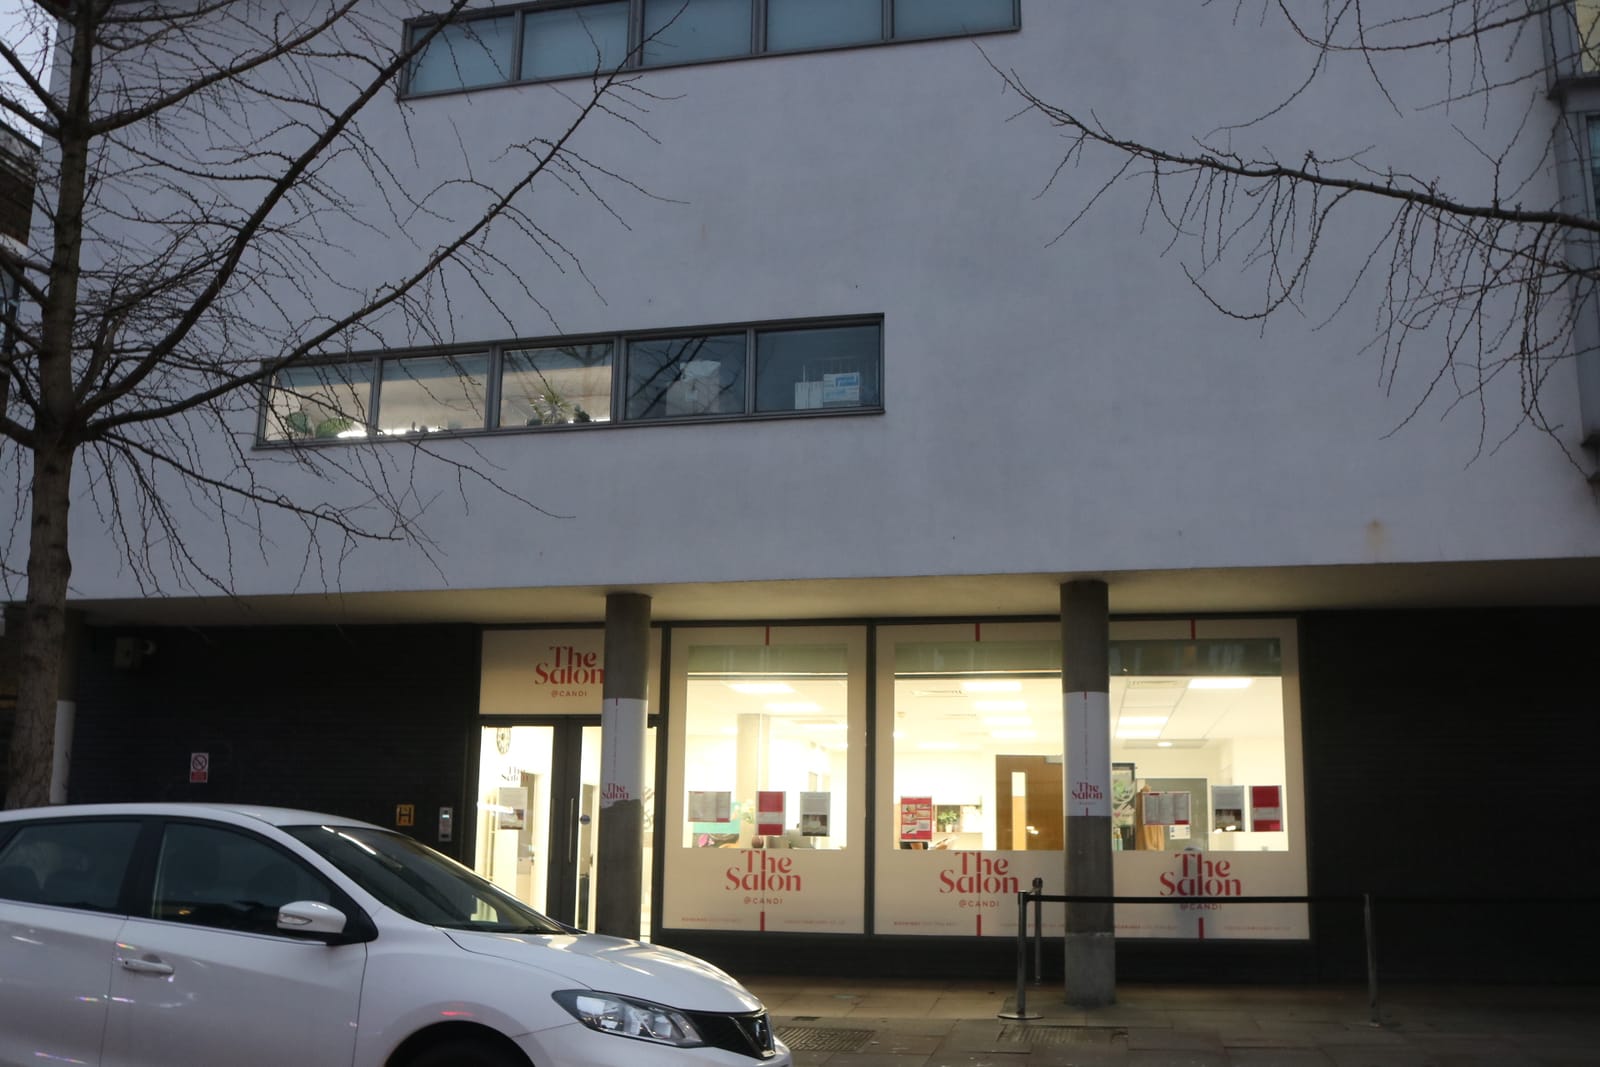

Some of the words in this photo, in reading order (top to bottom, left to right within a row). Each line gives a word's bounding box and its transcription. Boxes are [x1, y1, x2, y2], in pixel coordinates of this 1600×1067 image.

[549, 646, 597, 668] The
[534, 662, 605, 685] Salon
[551, 690, 587, 698] @CANDI
[601, 791, 630, 800] Salon
[606, 782, 626, 793] The
[1071, 790, 1103, 801] Salon
[1076, 781, 1100, 792] The
[740, 850, 793, 873] The
[954, 852, 1009, 876] The
[1174, 854, 1231, 878] The
[725, 867, 802, 891] Salon
[939, 869, 1019, 894] Salon
[1159, 872, 1242, 896] Salon
[743, 896, 784, 905] @CANDI
[958, 899, 1000, 908] @CANDI
